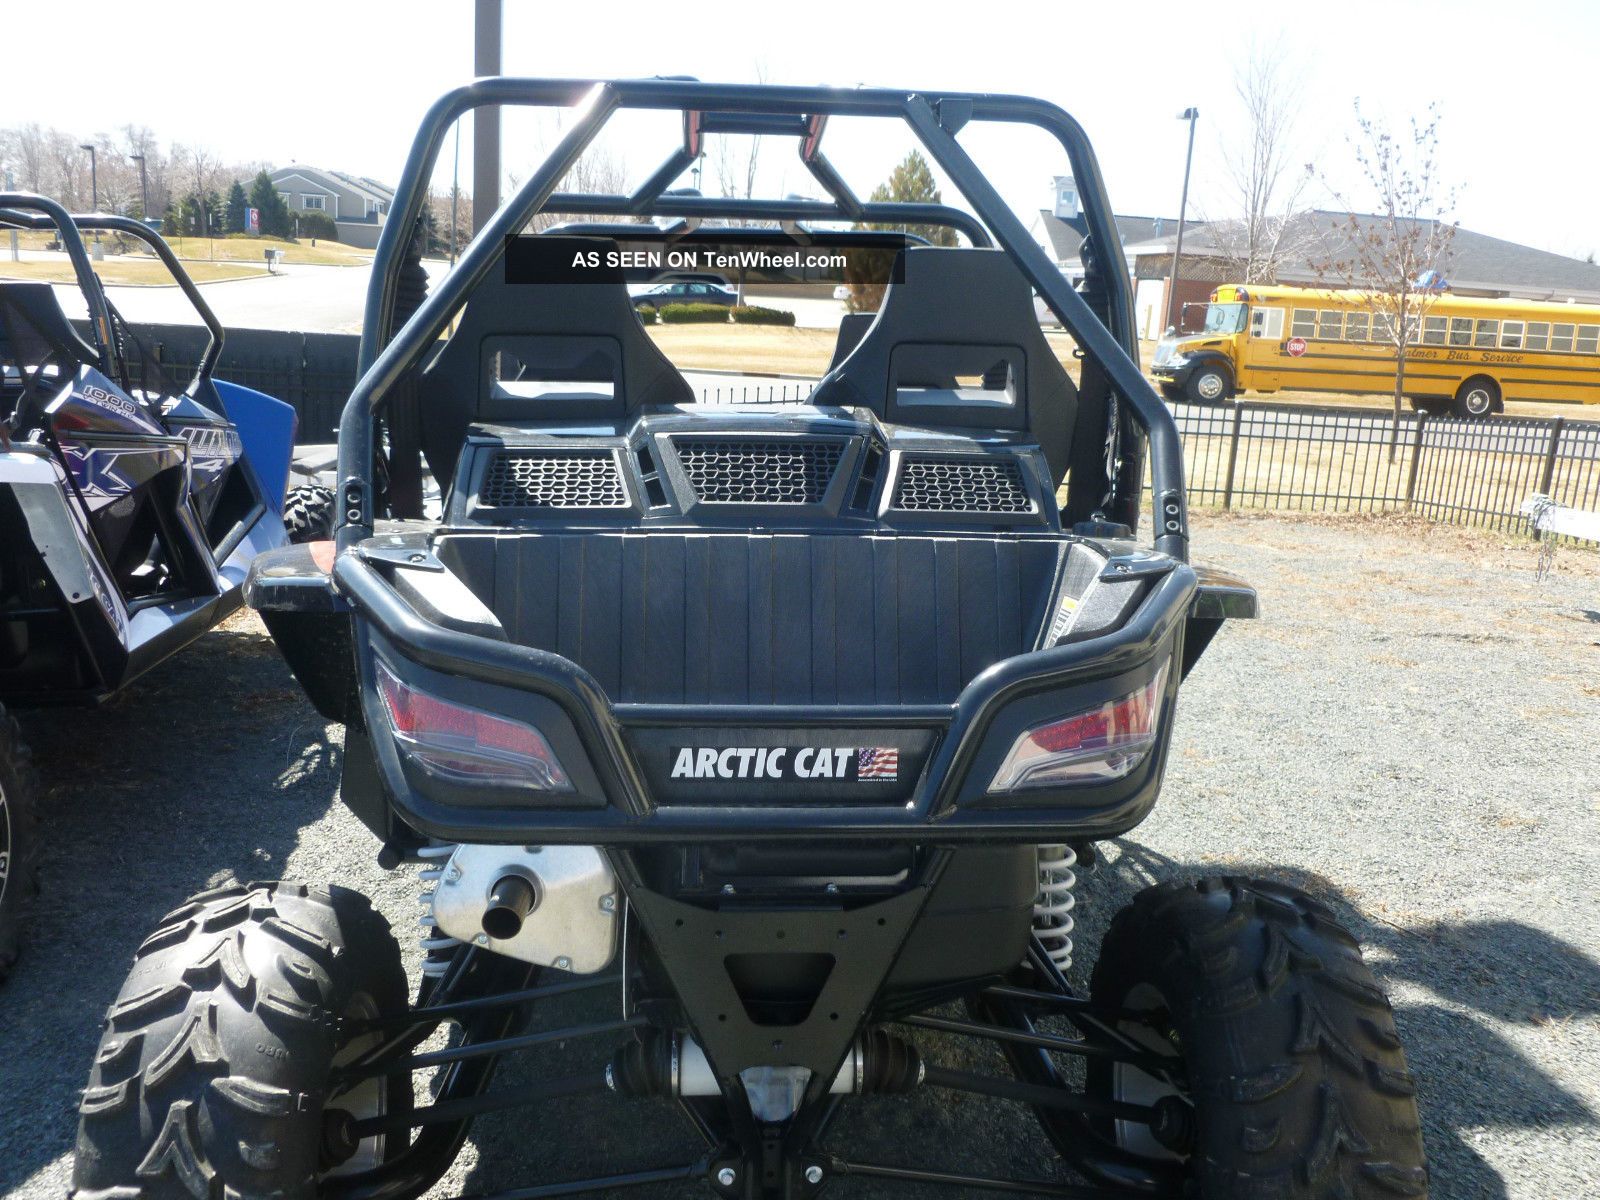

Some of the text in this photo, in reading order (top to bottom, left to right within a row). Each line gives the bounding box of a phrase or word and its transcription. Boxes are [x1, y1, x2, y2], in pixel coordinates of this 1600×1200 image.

[1289, 343, 1305, 351] STOP
[1446, 350, 1471, 361] Bus
[1480, 352, 1524, 363] Service
[83, 385, 136, 414] 1000
[670, 747, 855, 778] ARCTIC CAT
